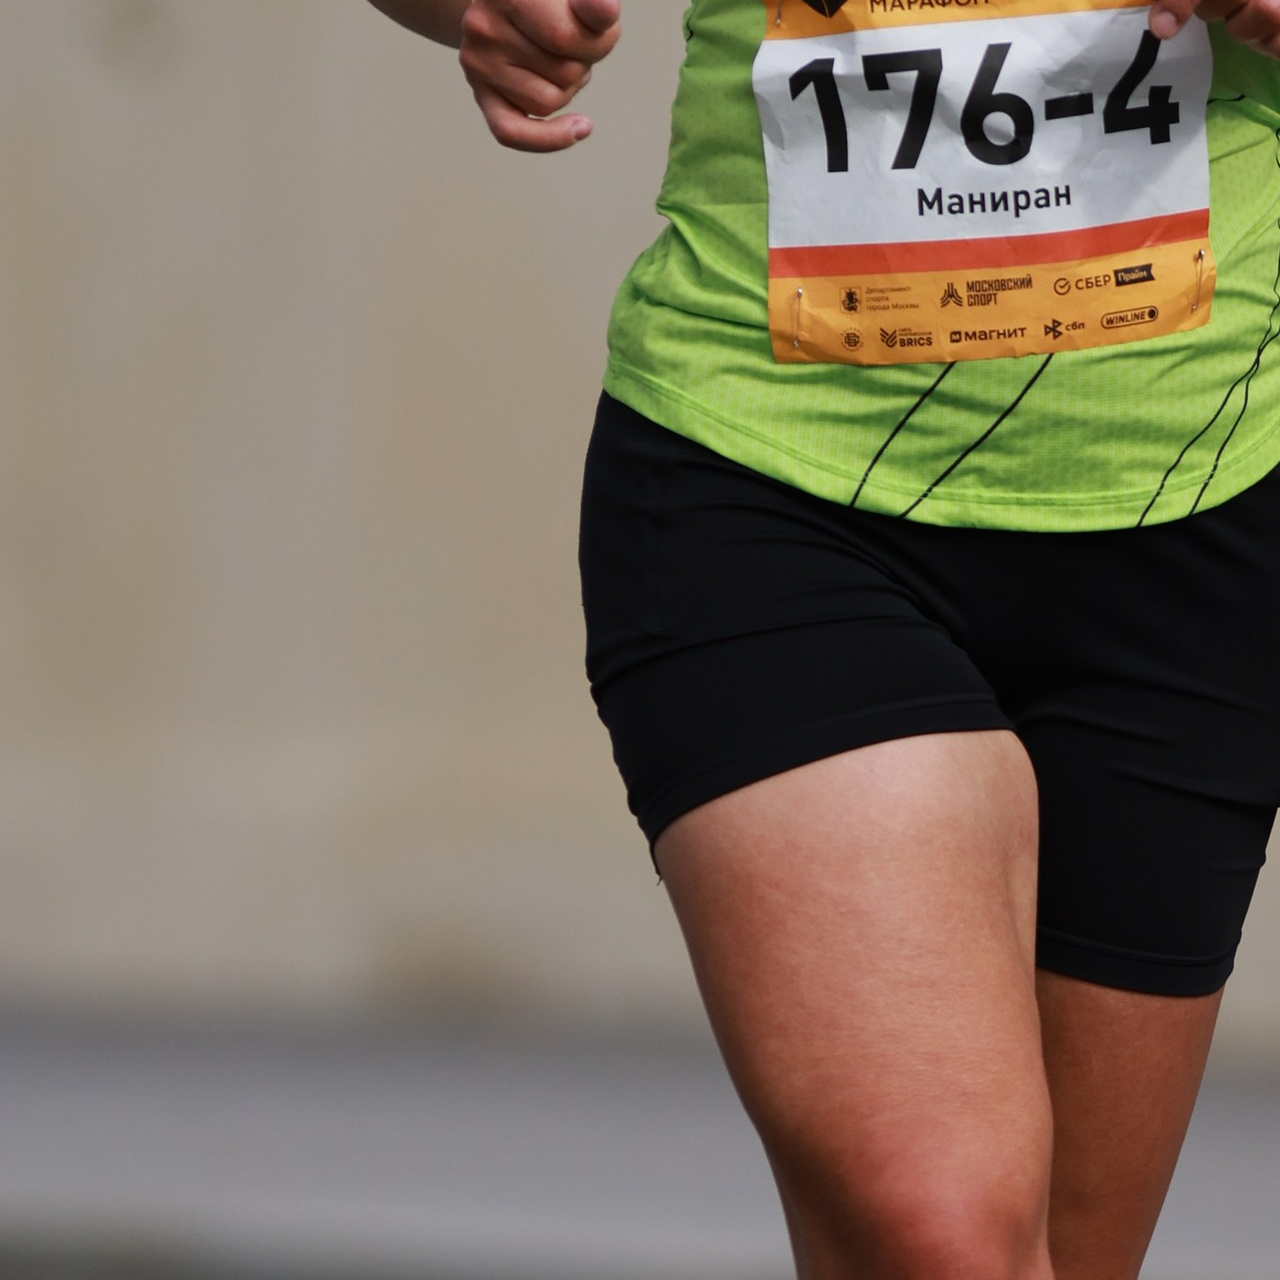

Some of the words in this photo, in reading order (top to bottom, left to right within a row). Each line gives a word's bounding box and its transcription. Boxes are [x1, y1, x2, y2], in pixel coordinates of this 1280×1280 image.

[788, 29, 1180, 173] 176-4
[917, 184, 1073, 217] Маниран
[966, 275, 1033, 294] МОСКОВСКИЙ
[1075, 274, 1112, 291] СБЕР
[967, 292, 999, 308] СПОРТ
[1105, 310, 1147, 326] WINLINE
[899, 336, 933, 348] BRICS
